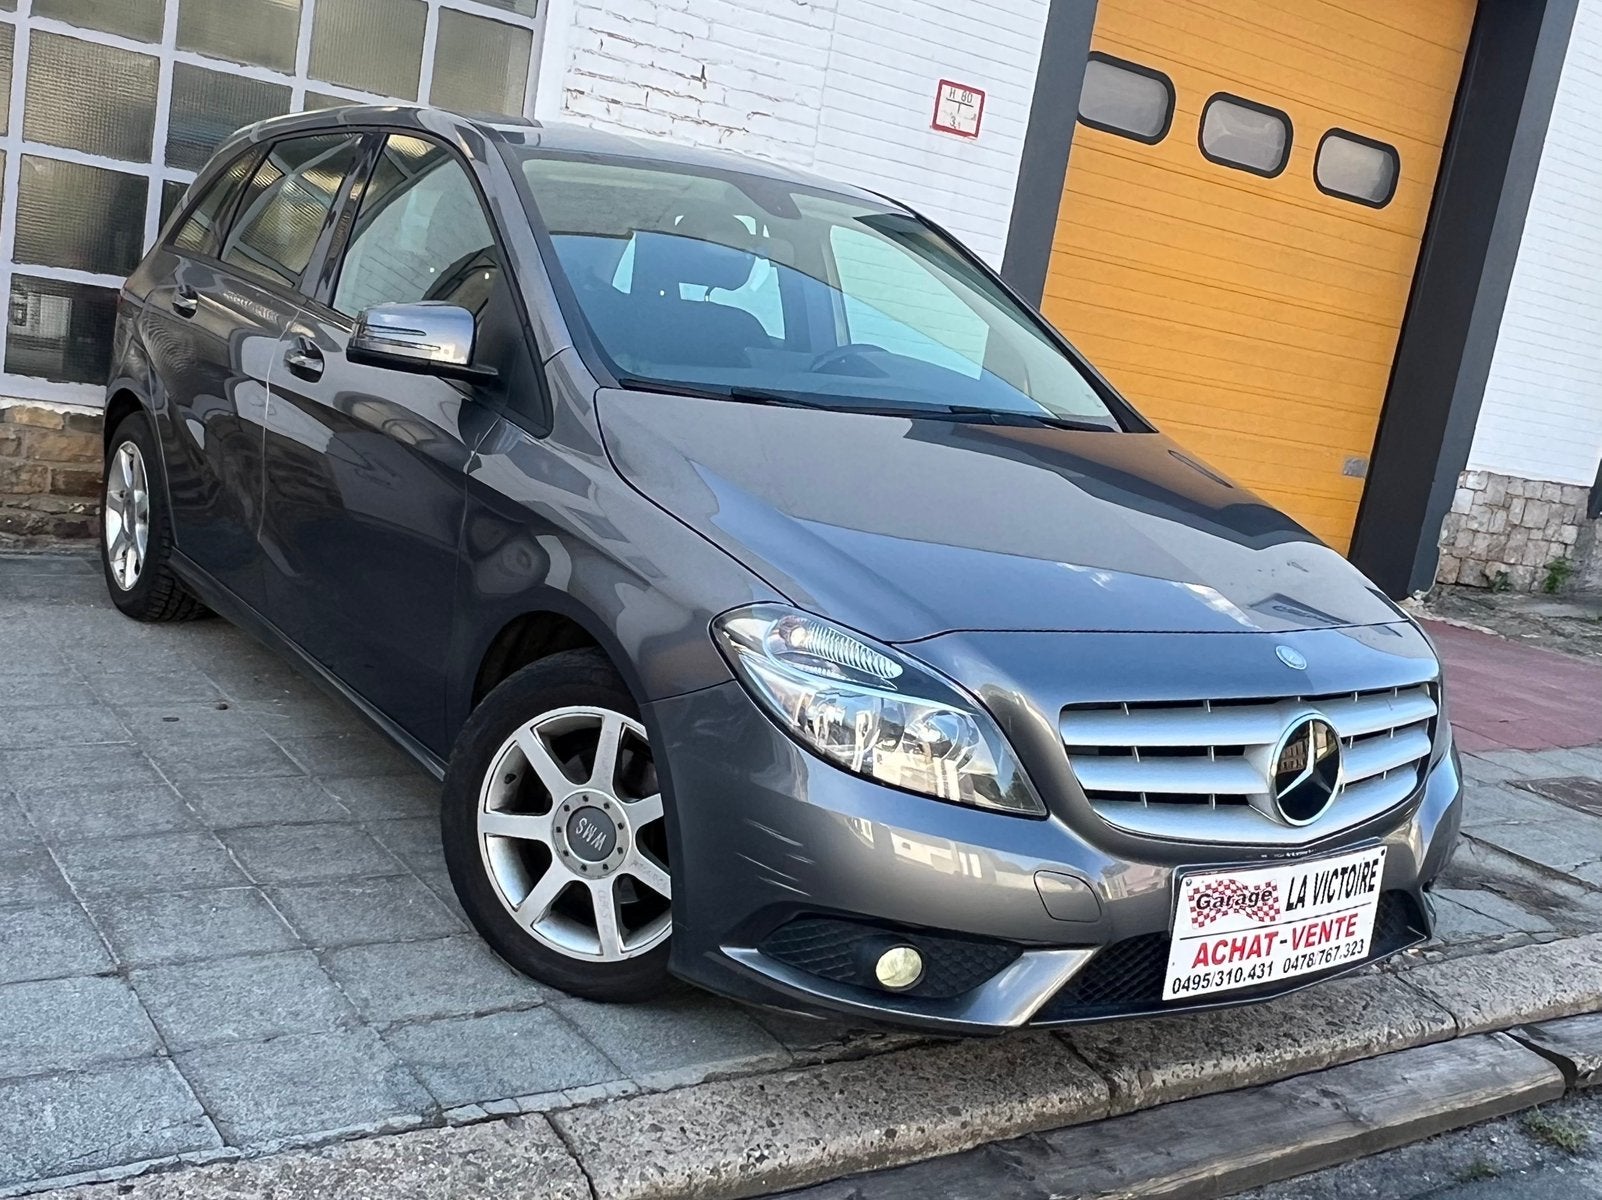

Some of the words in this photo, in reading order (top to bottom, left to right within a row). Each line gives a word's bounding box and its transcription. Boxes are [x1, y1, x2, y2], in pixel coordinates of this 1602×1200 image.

[949, 88, 956, 99] H
[961, 90, 973, 103] 80
[1195, 886, 1273, 911] Garage
[1286, 875, 1306, 912] LA
[1313, 858, 1379, 906] VICTOIRE
[1172, 960, 1274, 994] 0495/310.431
[1283, 938, 1364, 974] 0478/767.323
